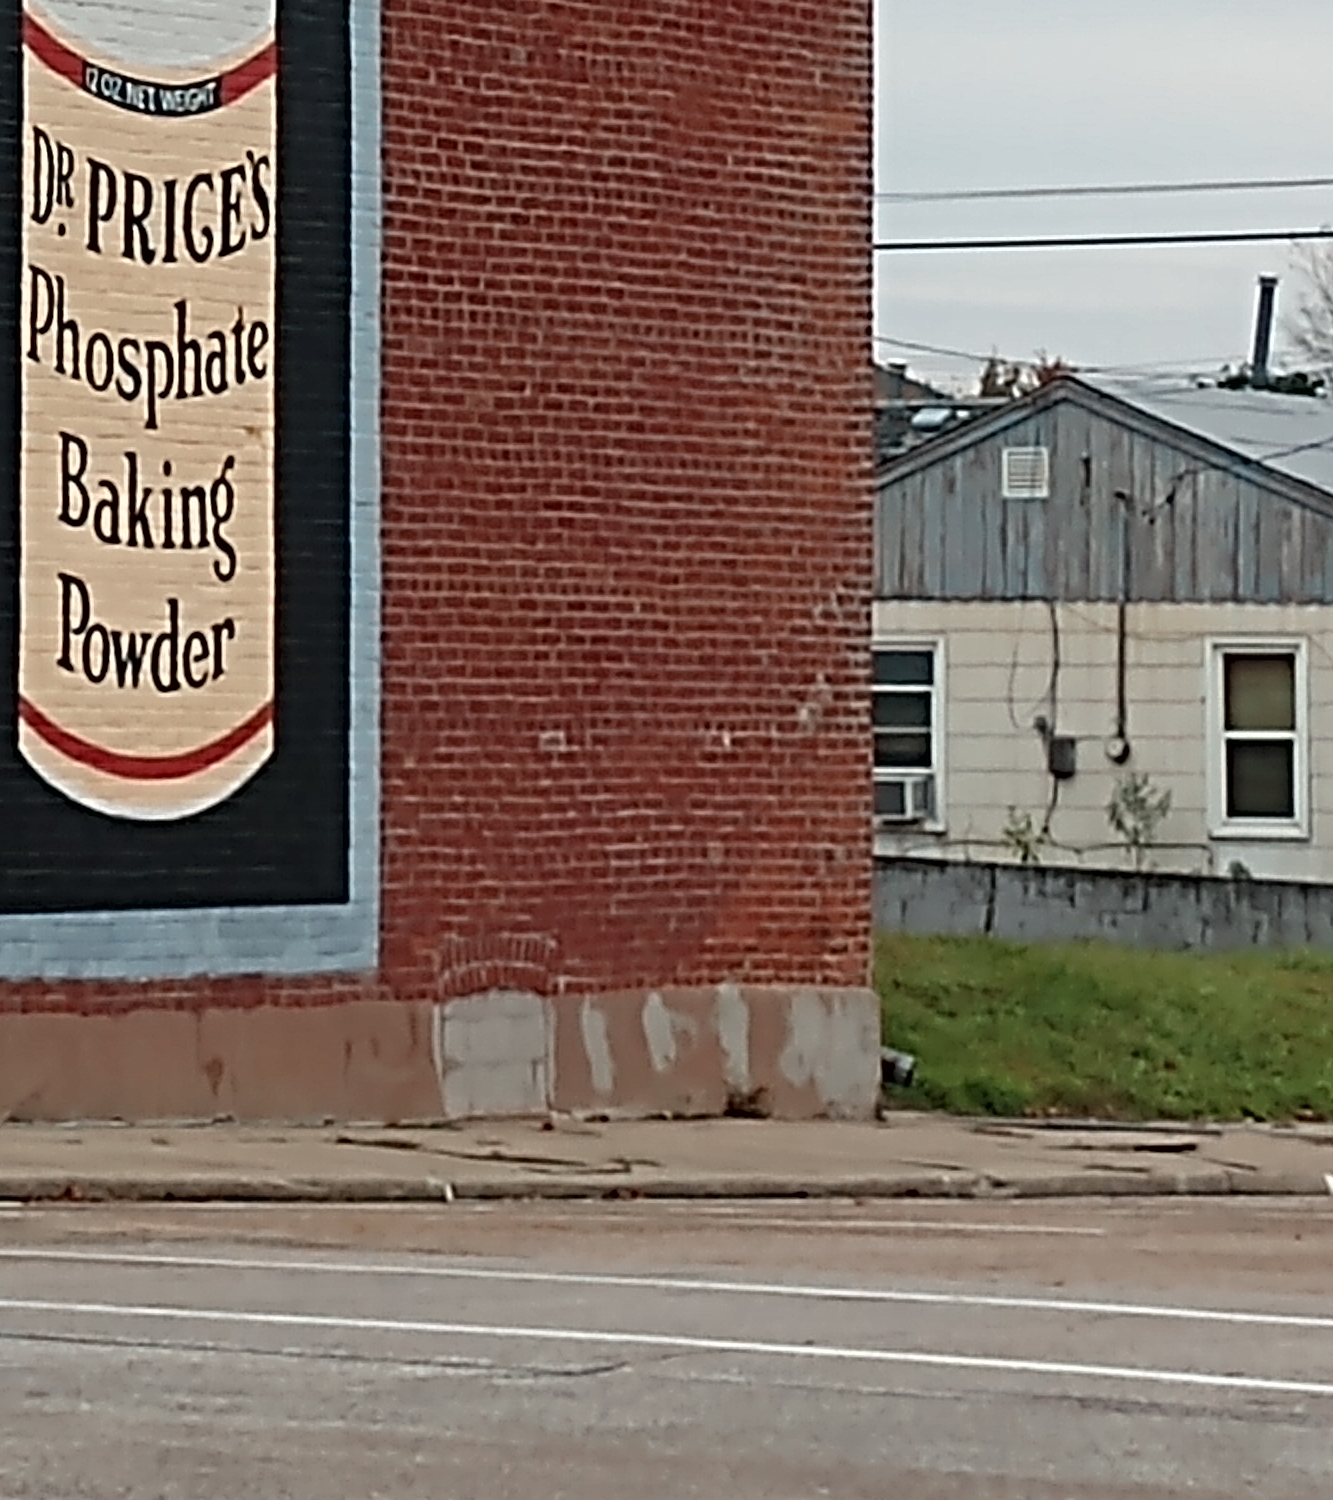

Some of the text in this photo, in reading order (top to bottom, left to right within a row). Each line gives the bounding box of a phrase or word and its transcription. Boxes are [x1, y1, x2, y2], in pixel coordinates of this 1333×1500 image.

[86, 150, 271, 265] PRICE'S
[28, 264, 269, 429] Phosphate
[58, 431, 237, 581] Baking
[57, 572, 236, 693] Powder
